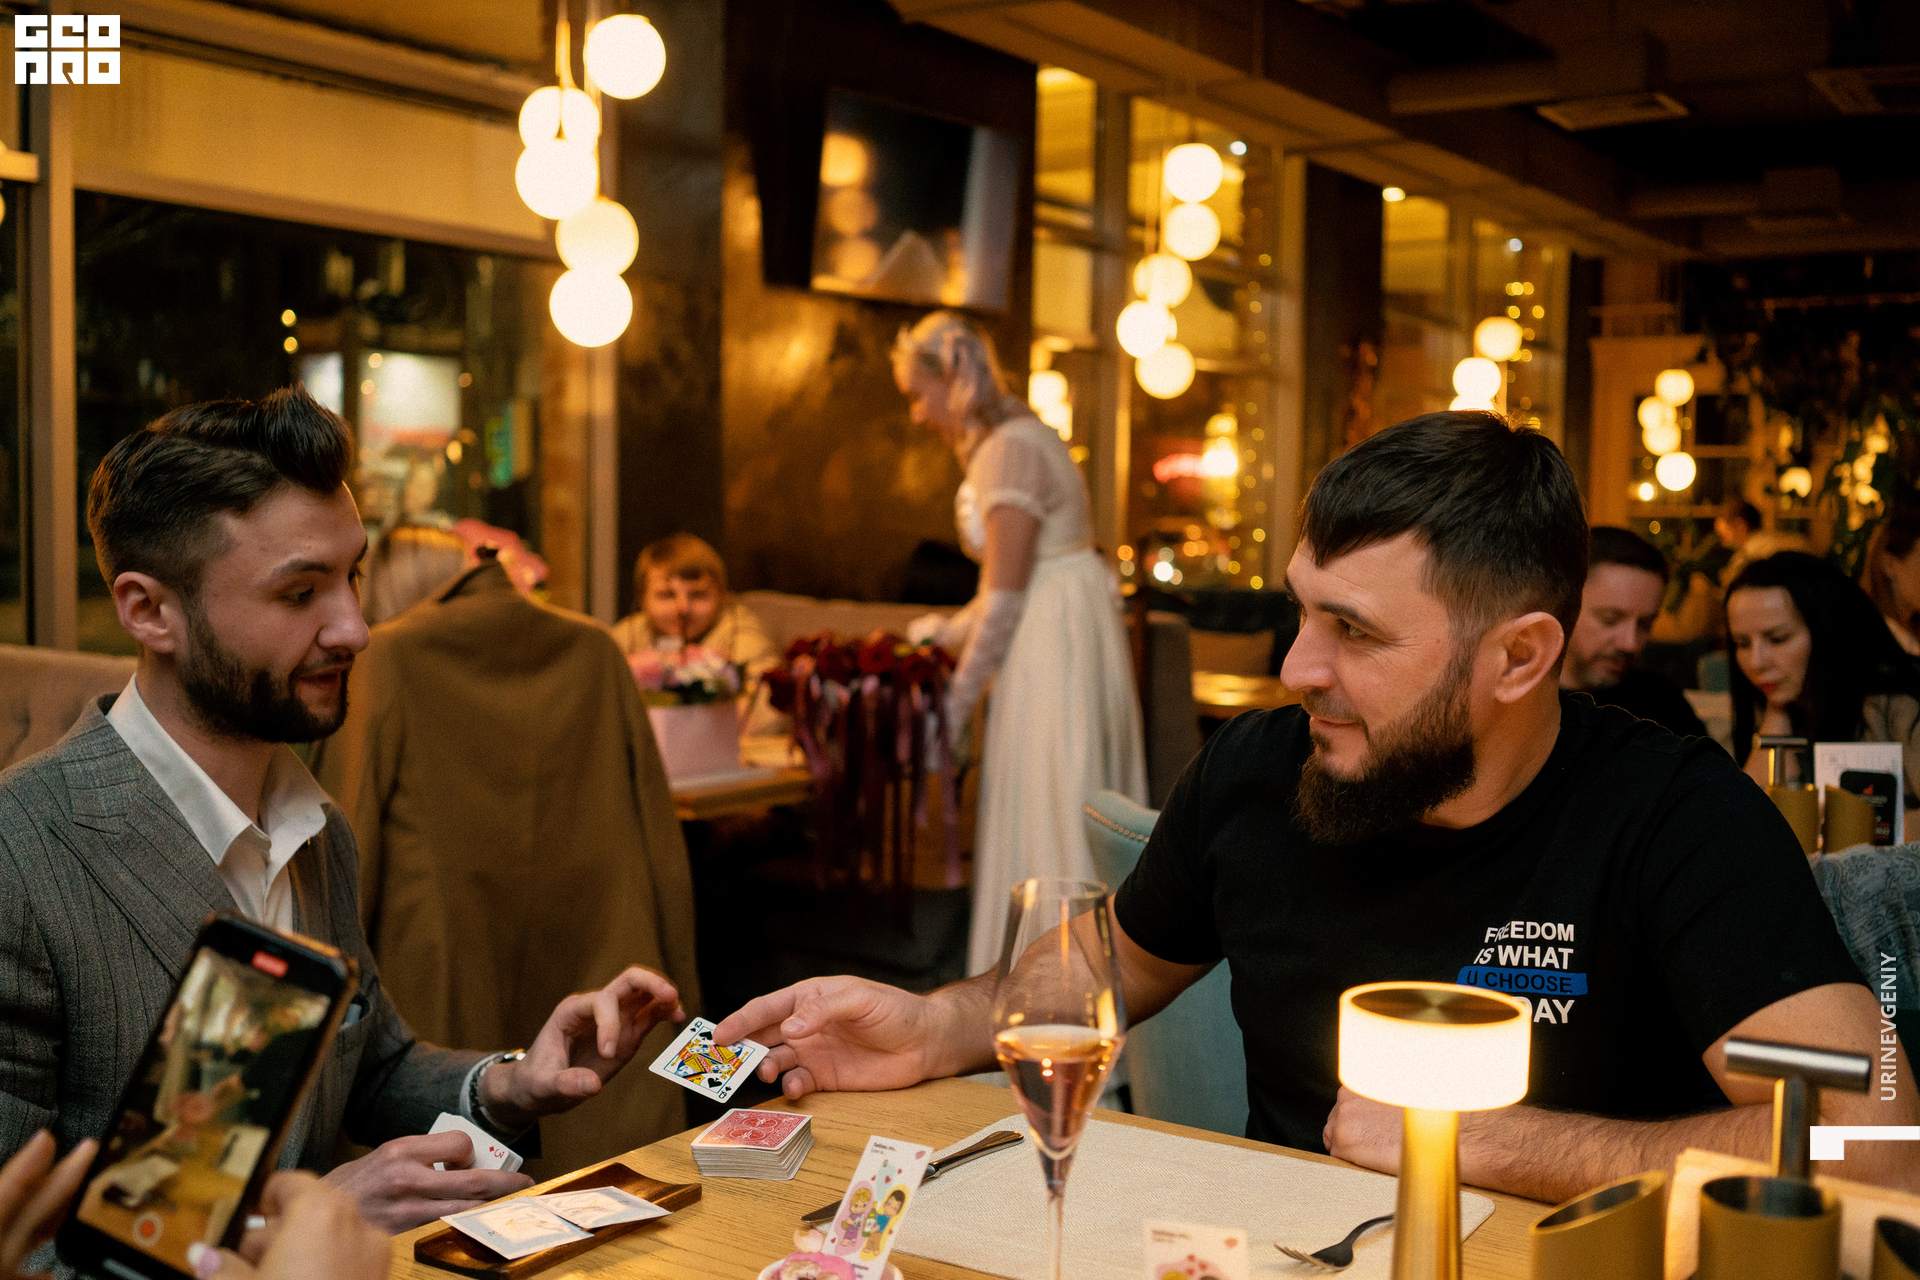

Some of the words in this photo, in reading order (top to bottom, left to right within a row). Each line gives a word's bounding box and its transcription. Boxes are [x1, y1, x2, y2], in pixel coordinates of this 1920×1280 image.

[1484, 921, 1575, 943] FREEDOM
[1473, 947, 1495, 965] IS
[1498, 945, 1574, 969] WHAT
[1466, 970, 1478, 985] U
[1484, 971, 1573, 993] CHOOSE
[494, 1148, 505, 1159] 3
